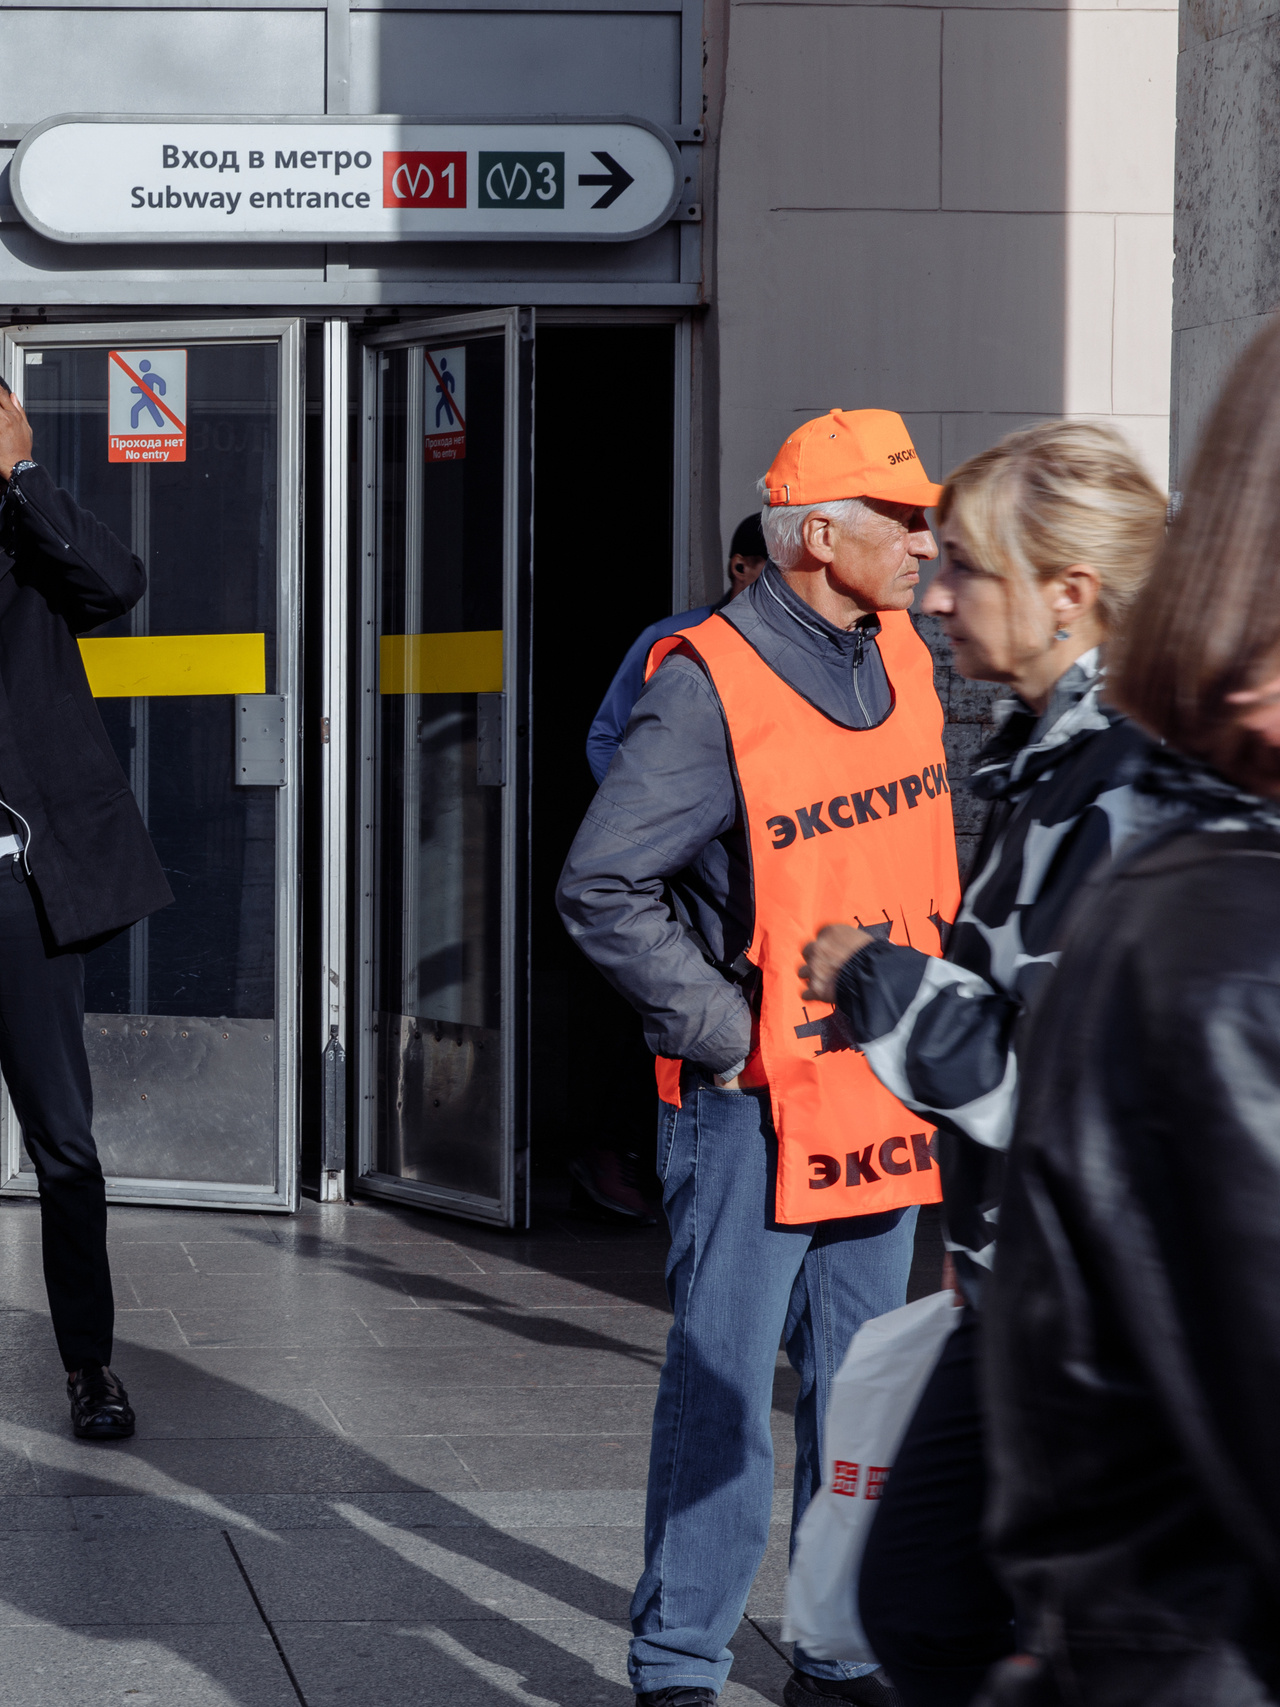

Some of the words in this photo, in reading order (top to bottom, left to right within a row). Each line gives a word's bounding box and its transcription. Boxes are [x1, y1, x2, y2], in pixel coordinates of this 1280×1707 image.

[162, 144, 240, 174] Вход
[248, 150, 265, 169] в
[274, 150, 372, 176] метро
[130, 184, 242, 215] Subway
[249, 187, 371, 209] entrance
[111, 437, 162, 451] Прохода
[164, 438, 185, 448] нет
[125, 449, 141, 460] No
[142, 450, 170, 462] entry
[887, 449, 917, 466] ЭКСК
[766, 762, 949, 850] ЭКСКУРСИ
